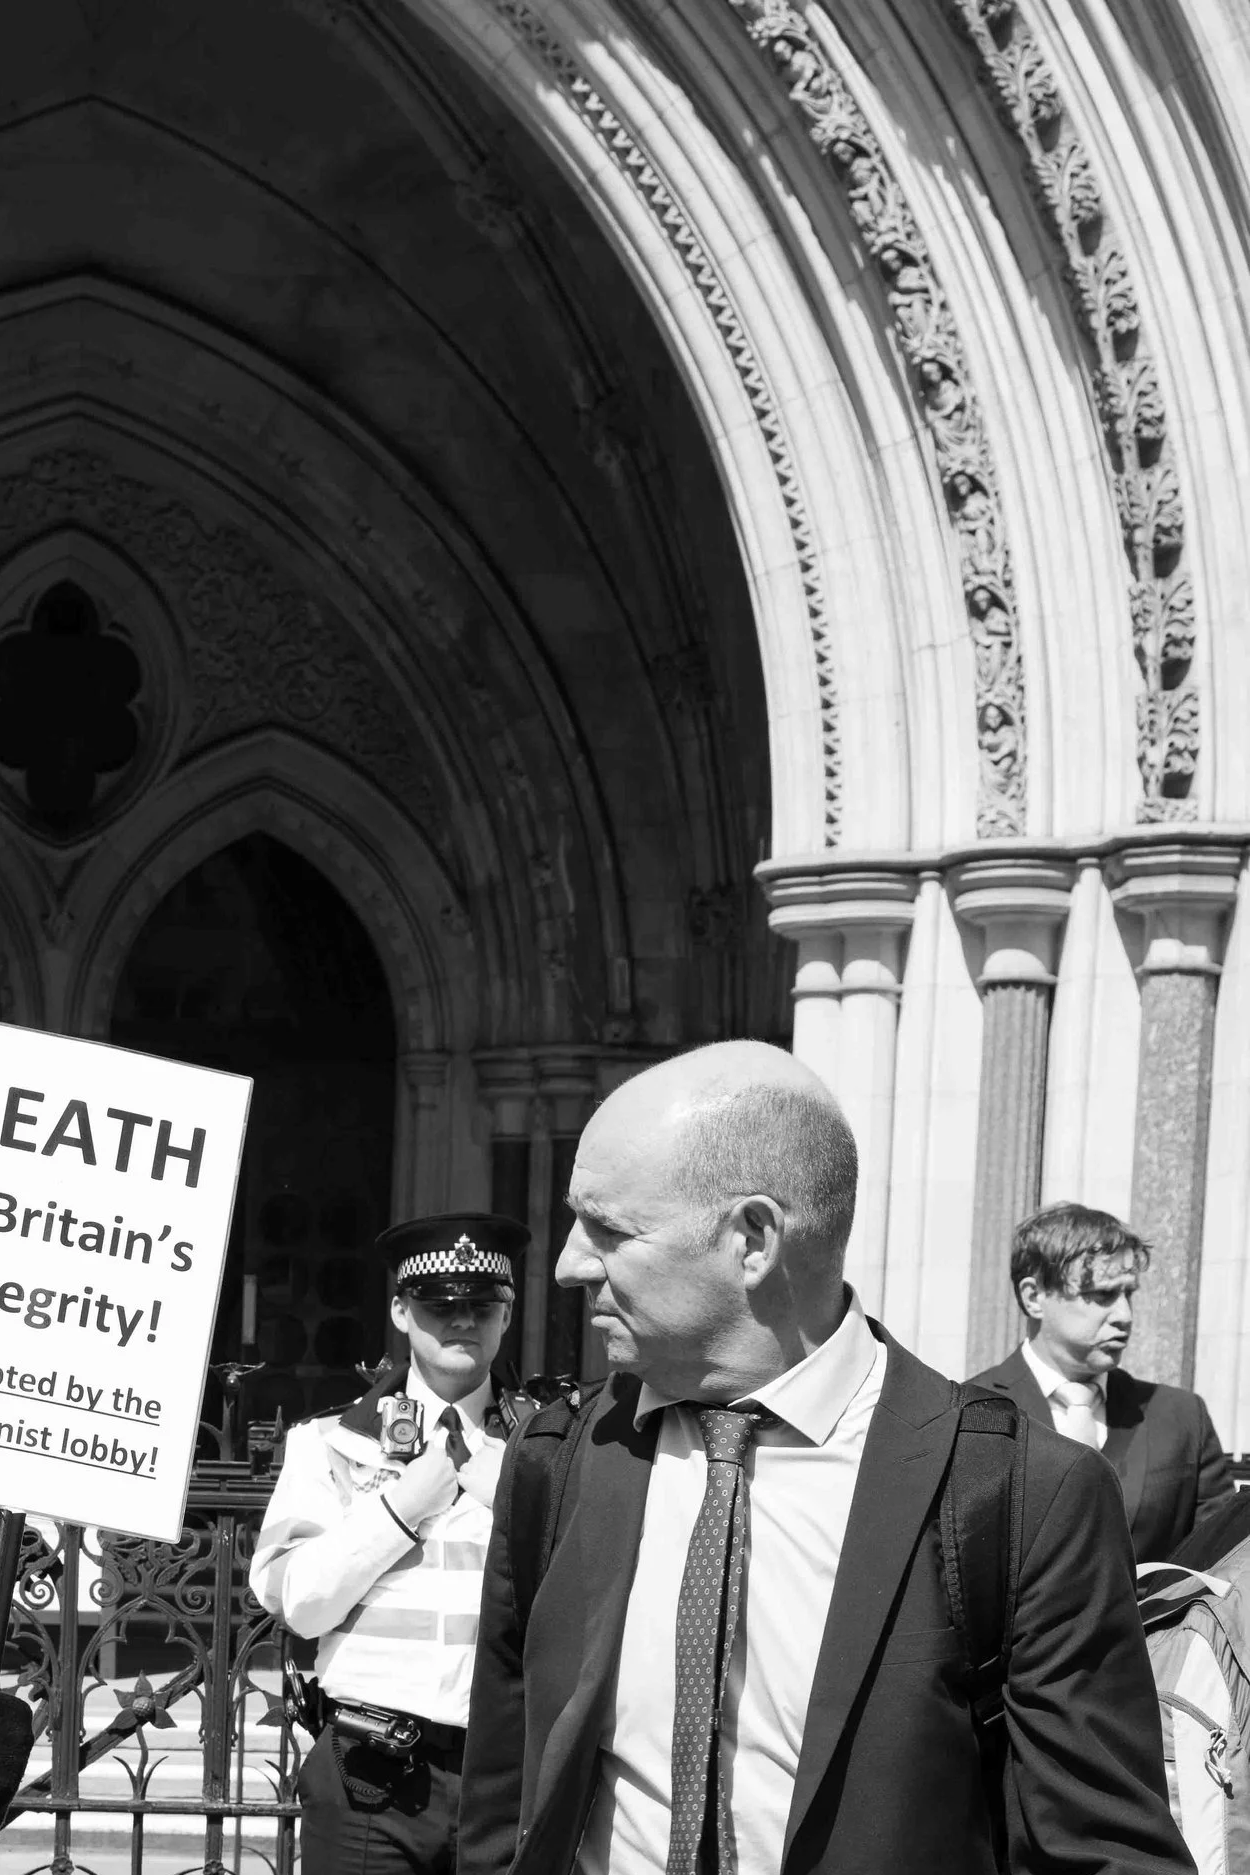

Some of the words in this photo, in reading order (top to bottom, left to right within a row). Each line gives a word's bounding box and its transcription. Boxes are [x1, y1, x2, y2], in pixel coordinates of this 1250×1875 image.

[66, 1375, 103, 1409] by
[113, 1388, 161, 1419] the
[61, 1428, 158, 1475] lobby!
